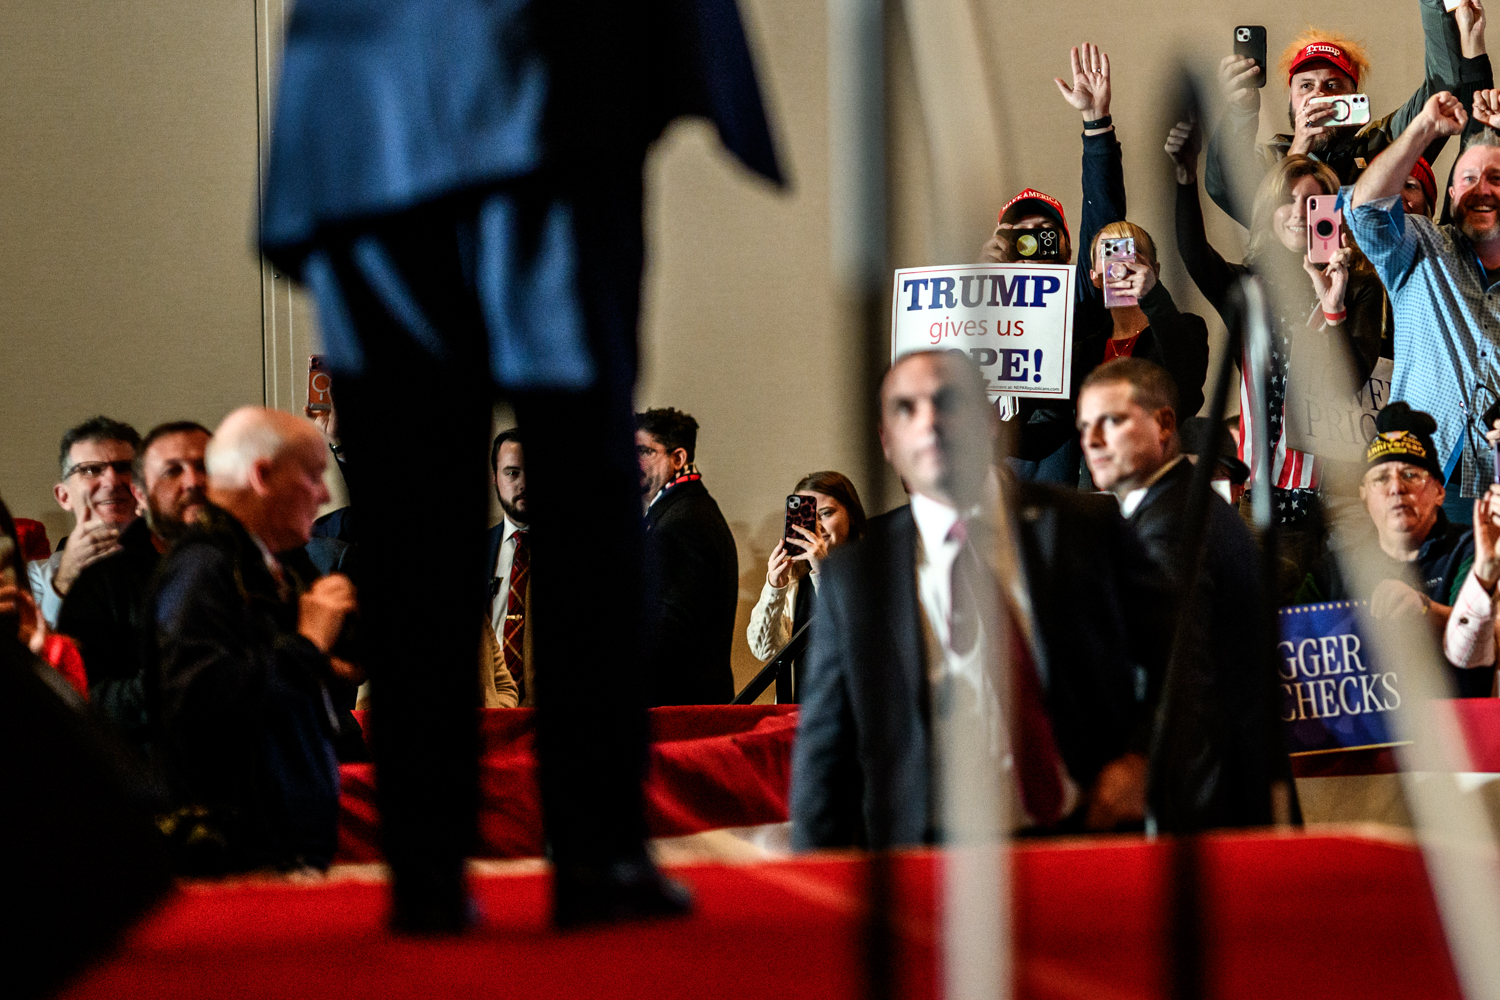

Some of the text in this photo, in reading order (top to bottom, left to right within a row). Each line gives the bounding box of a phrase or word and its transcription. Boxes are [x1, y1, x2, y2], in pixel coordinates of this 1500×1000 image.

[1306, 44, 1341, 57] Trump
[1023, 190, 1060, 207] AMERICA
[903, 274, 1061, 312] TRUMP
[929, 316, 1025, 345] gives us
